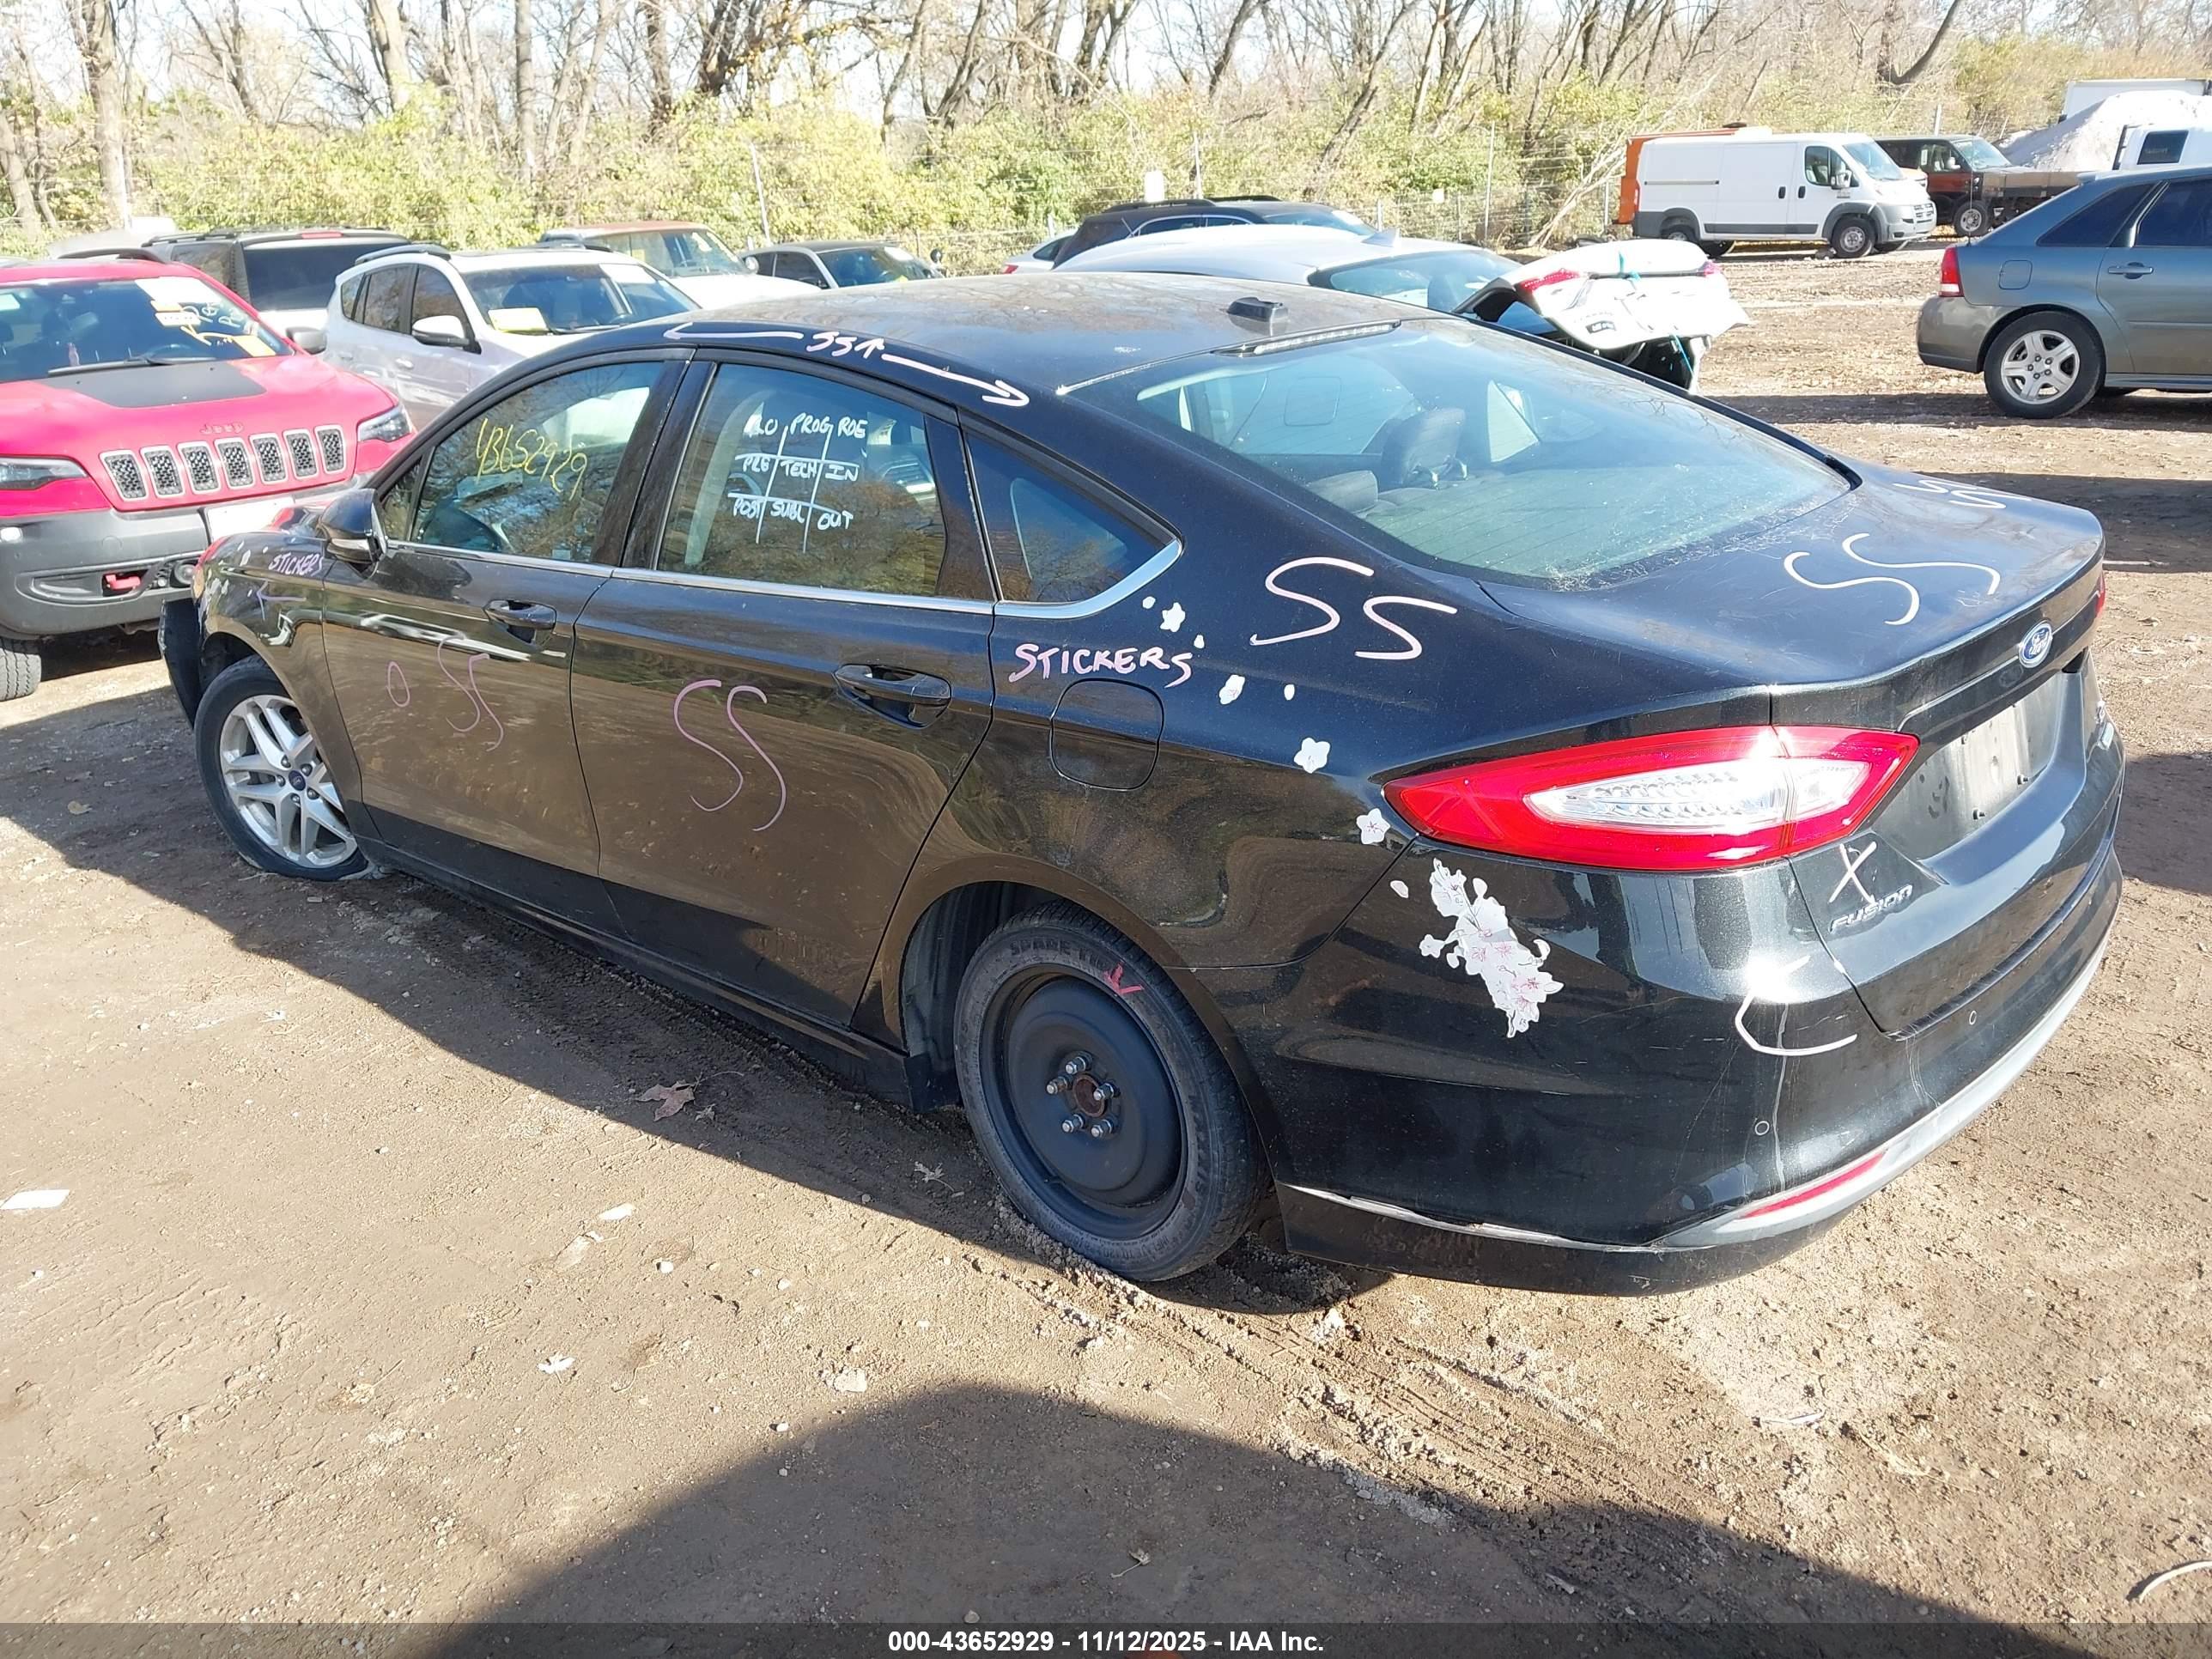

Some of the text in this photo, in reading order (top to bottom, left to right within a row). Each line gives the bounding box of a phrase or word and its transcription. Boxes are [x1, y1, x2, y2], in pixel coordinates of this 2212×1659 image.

[780, 459, 817, 477] TECH
[824, 464, 859, 482] IN
[817, 510, 854, 531] OUT
[268, 552, 325, 577] STICKERS
[1249, 556, 1458, 660] SS
[1008, 643, 1194, 688] STICKERS
[673, 678, 787, 831] SS
